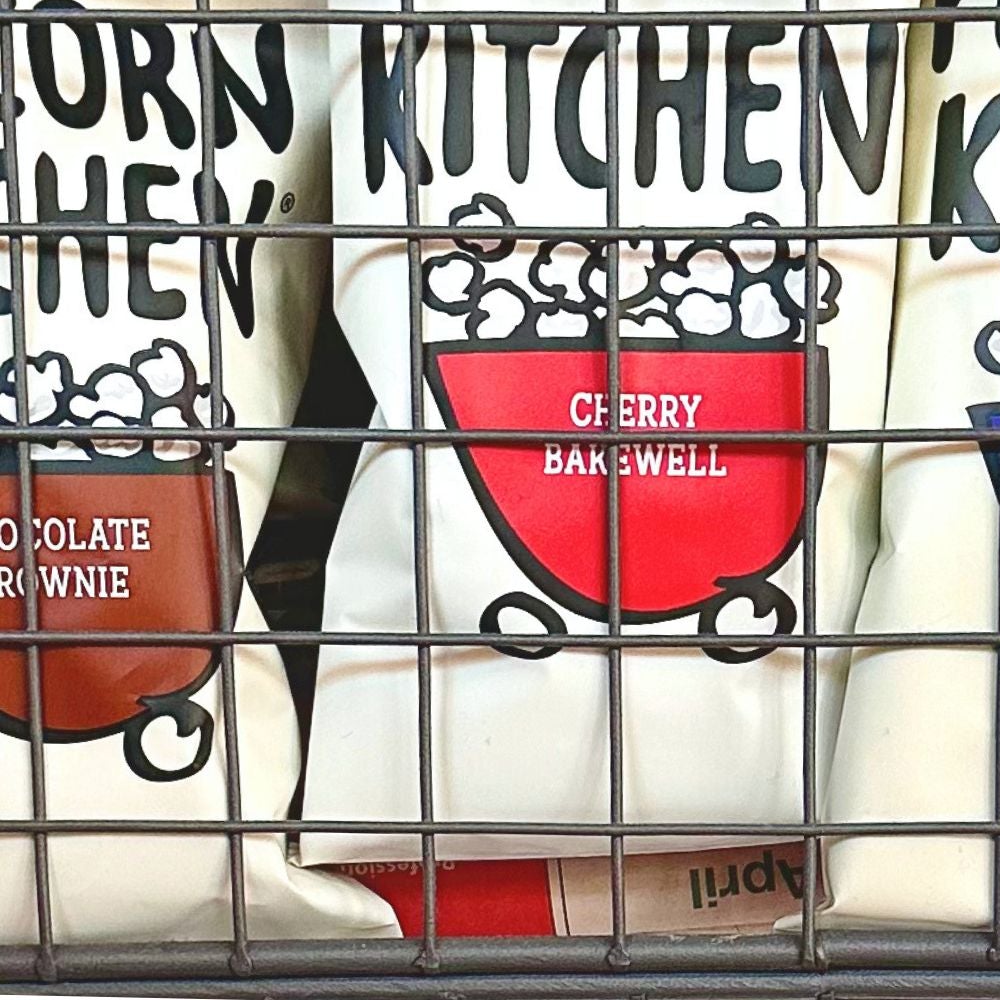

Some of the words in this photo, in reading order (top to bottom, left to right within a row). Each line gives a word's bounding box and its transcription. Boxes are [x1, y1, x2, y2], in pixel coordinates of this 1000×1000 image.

[360, 22, 899, 196] KITCHEN
[0, 150, 276, 340] HEN
[569, 391, 703, 429] CHERRY
[543, 442, 728, 478] BAKEWELL
[689, 848, 810, 910] April
